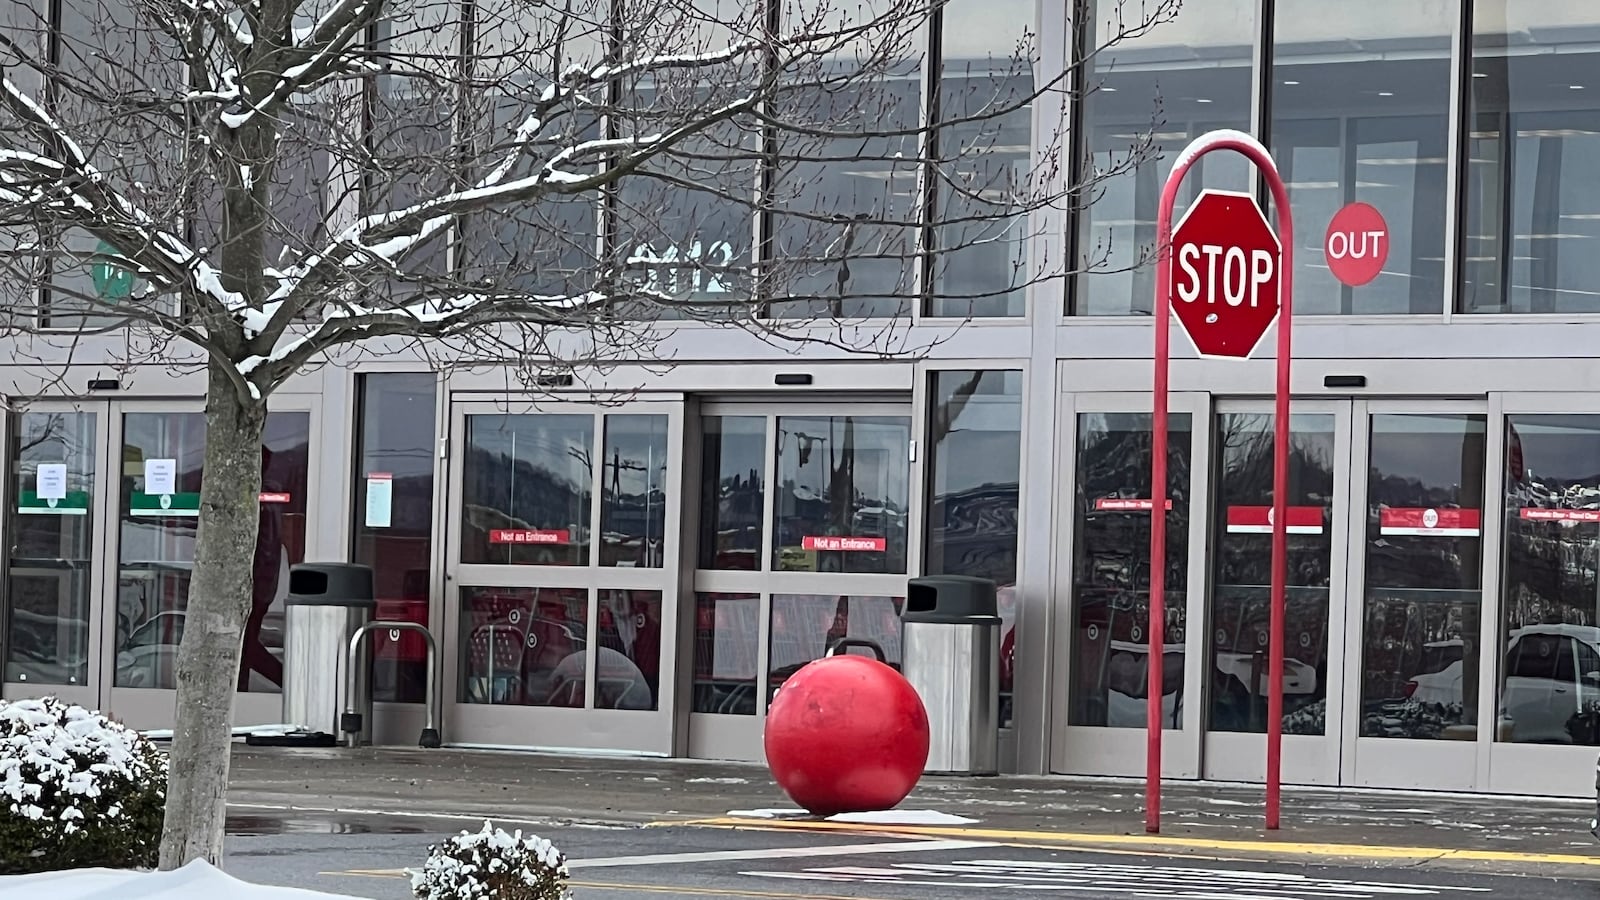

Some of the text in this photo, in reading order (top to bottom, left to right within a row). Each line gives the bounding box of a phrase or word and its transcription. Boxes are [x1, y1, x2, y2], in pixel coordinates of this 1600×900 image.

[1328, 231, 1385, 259] OUT
[1177, 243, 1274, 307] STOP
[1424, 514, 1437, 522] OUT
[500, 531, 558, 542] Not an Entrance
[813, 537, 876, 550] Not an Entrance
